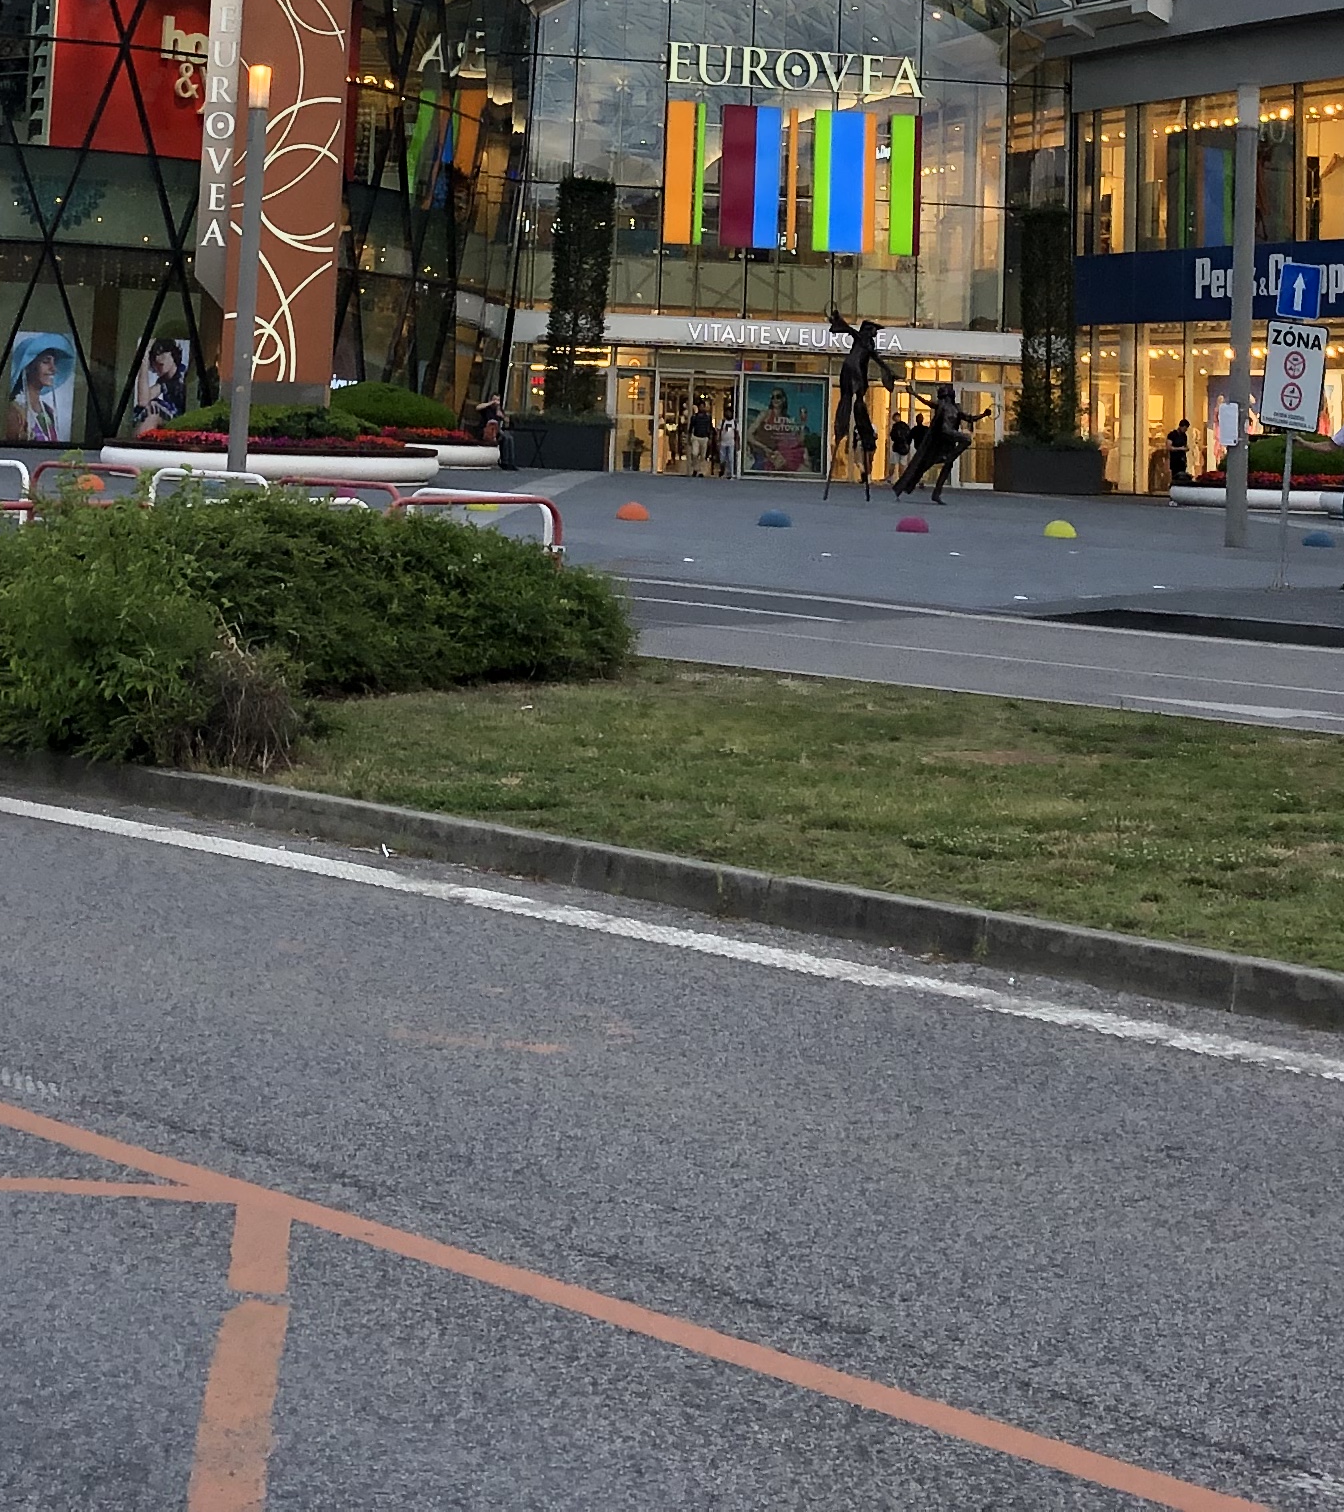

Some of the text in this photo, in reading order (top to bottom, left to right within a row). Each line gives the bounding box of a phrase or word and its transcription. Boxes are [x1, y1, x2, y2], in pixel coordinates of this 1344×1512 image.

[667, 42, 925, 98] EUROVEA
[201, 5, 237, 248] EUROVEA
[688, 322, 771, 345] VITAJTE
[776, 328, 790, 345] V
[1272, 326, 1322, 351] ZÓNA
